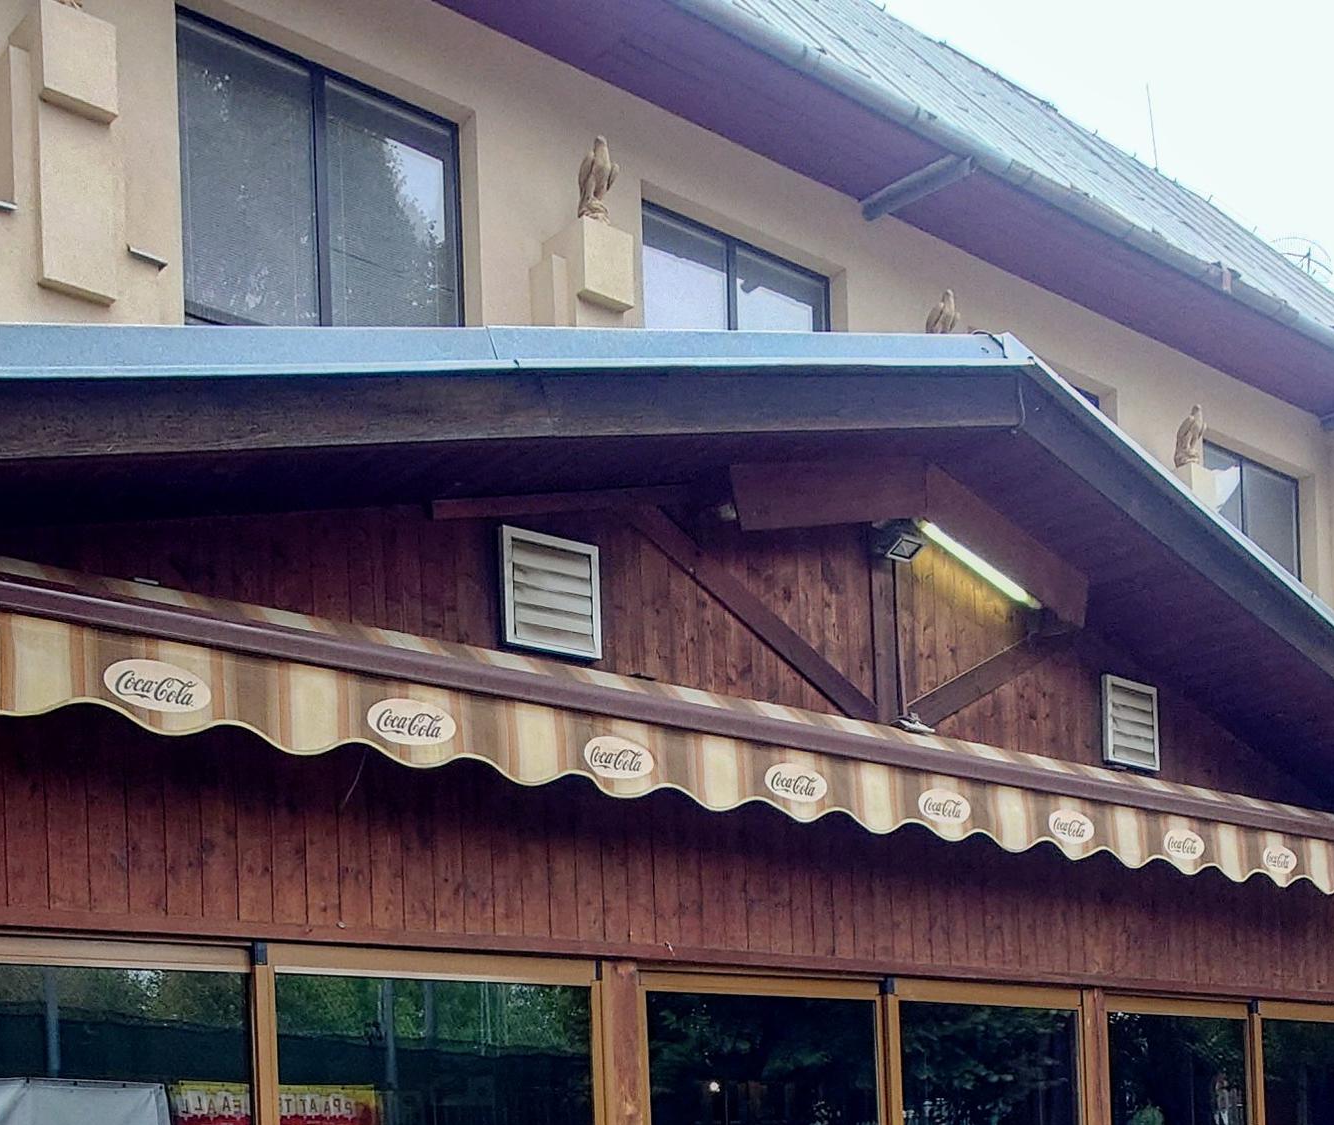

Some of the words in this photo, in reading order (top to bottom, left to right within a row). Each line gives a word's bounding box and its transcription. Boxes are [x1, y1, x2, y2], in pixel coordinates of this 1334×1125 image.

[115, 669, 198, 707] Coca-Cola
[375, 707, 442, 740] Coca-Cola
[589, 744, 643, 773] Coca-Cola
[770, 770, 820, 798] Coca-Cola
